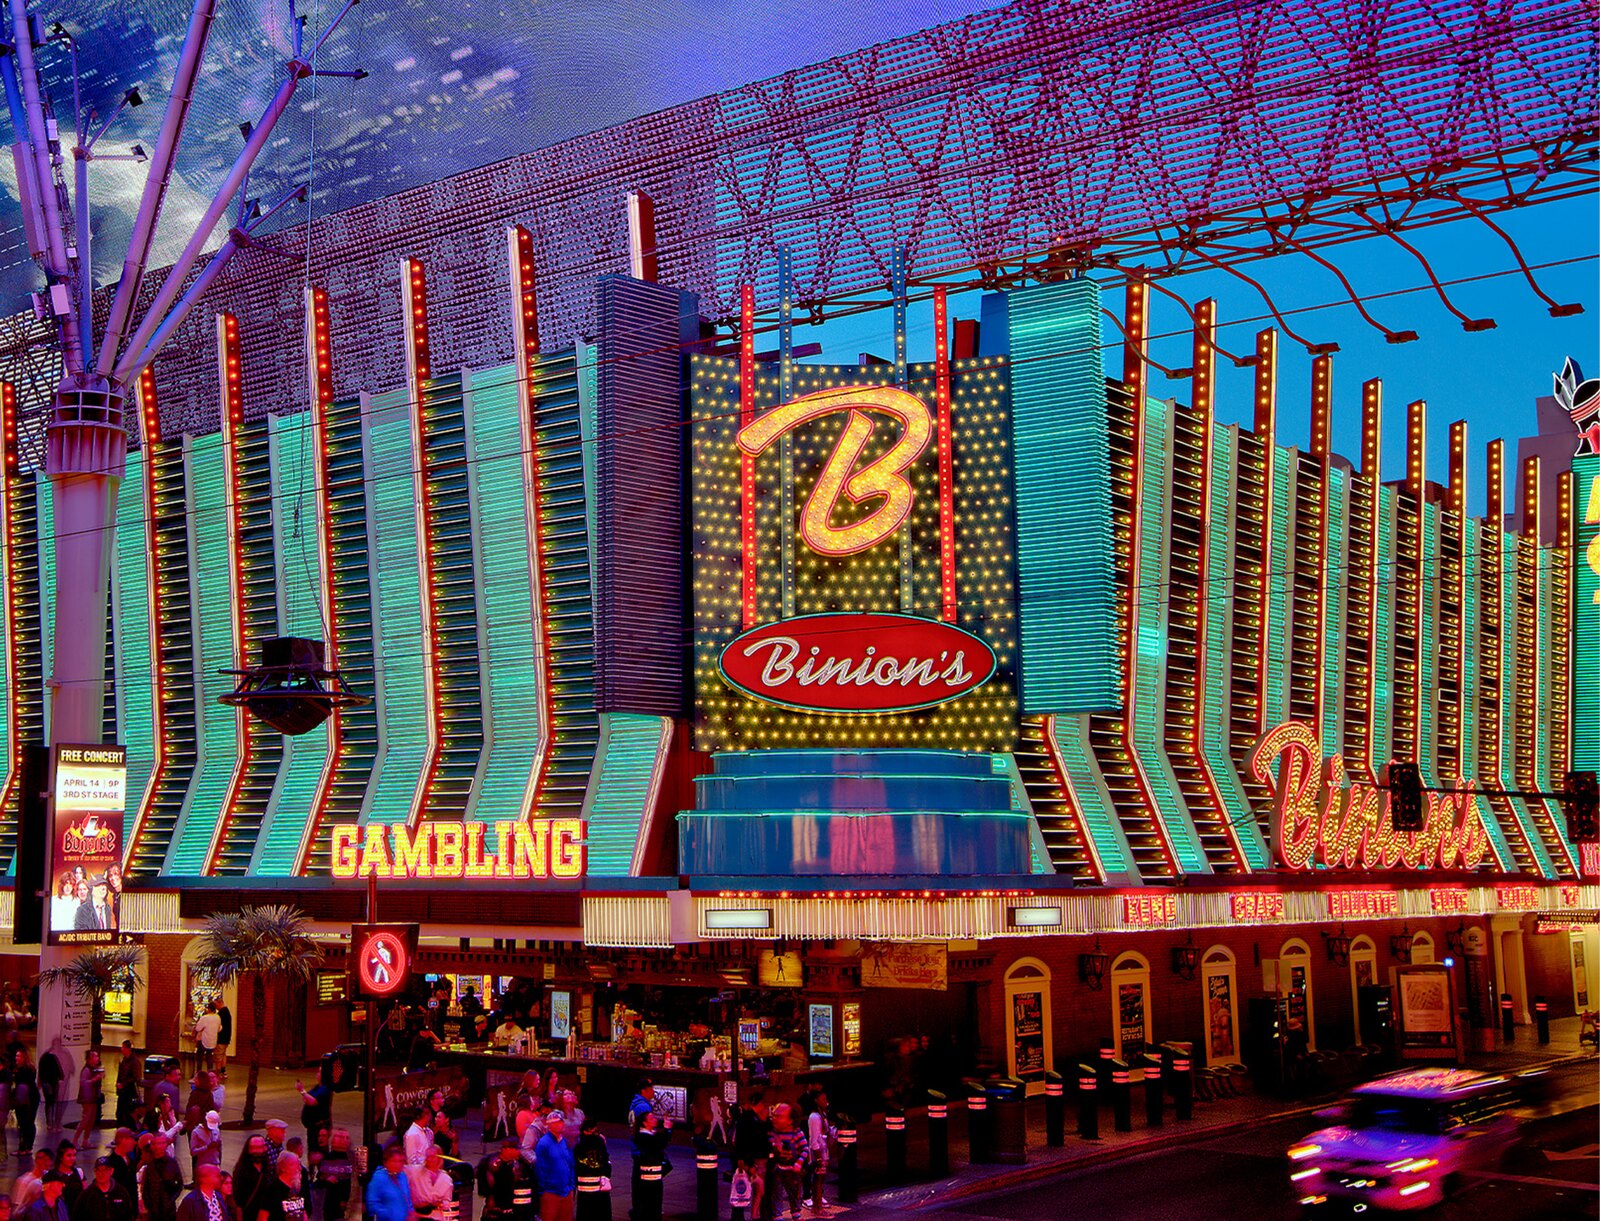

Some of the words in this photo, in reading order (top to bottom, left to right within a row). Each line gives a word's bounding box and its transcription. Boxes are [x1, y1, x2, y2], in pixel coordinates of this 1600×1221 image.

[736, 384, 933, 558] B
[743, 636, 974, 688] Binion's
[60, 750, 82, 762] FREE
[83, 750, 124, 763] CONCERT
[63, 779, 88, 787] APRIL
[90, 779, 99, 787] 14
[63, 790, 80, 798] 3RD
[81, 791, 92, 799] ST
[92, 791, 119, 799] STAGE
[331, 818, 584, 880] GAMBLING
[1127, 896, 1177, 925] KENO
[1233, 893, 1284, 922] CRAPS
[1330, 890, 1398, 916] ROULETTE
[58, 933, 76, 942] AC/DC
[76, 932, 97, 942] TRIBUTE
[97, 932, 112, 941] BAND
